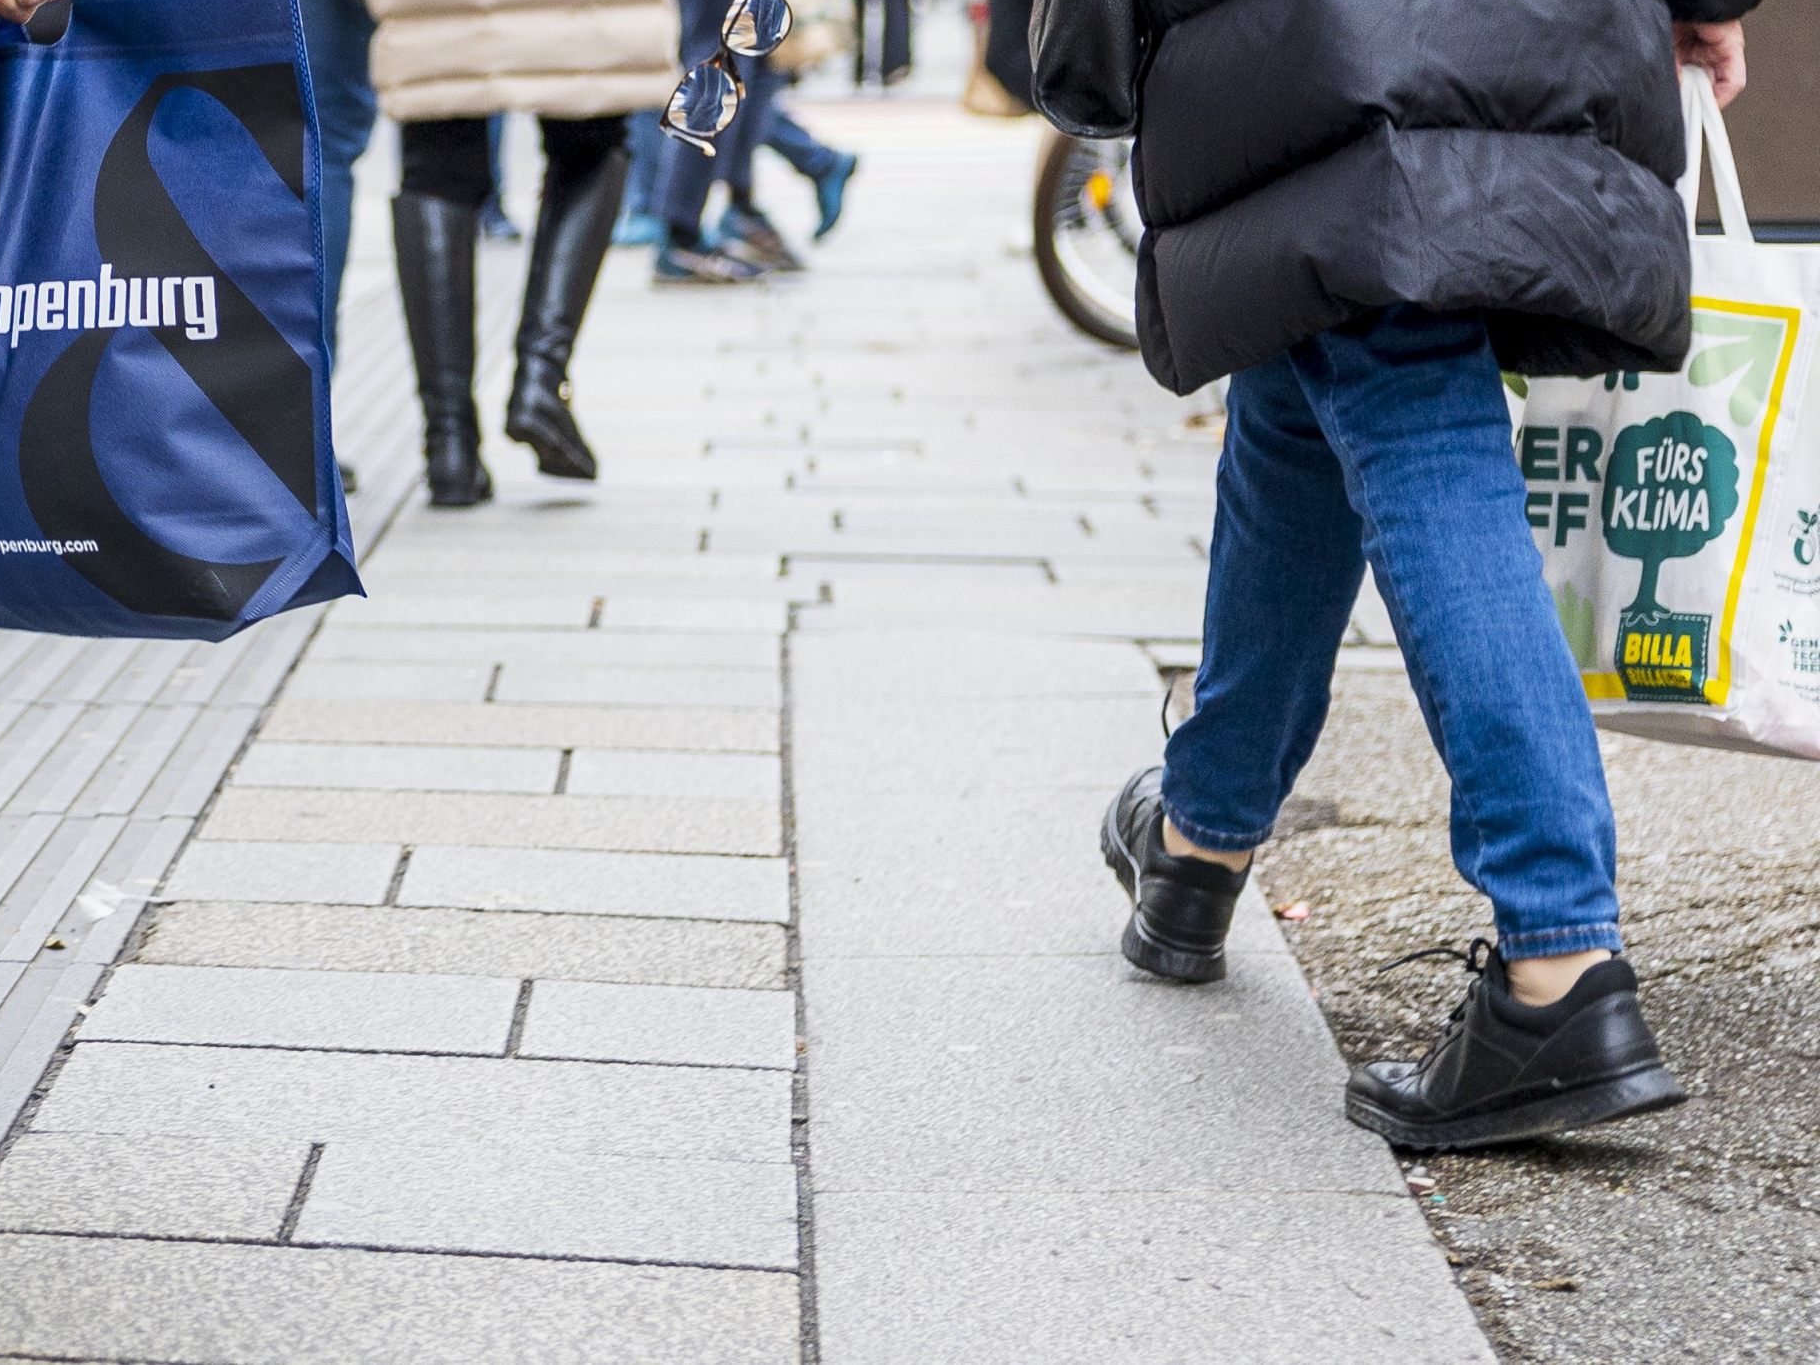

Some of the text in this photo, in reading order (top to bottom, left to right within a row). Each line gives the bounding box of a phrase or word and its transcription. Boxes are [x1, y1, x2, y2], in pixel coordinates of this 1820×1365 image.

[1521, 426, 1604, 483] ER
[1636, 438, 1709, 485] FÜRS
[1527, 492, 1590, 547] FF
[1624, 632, 1692, 668] BILLA
